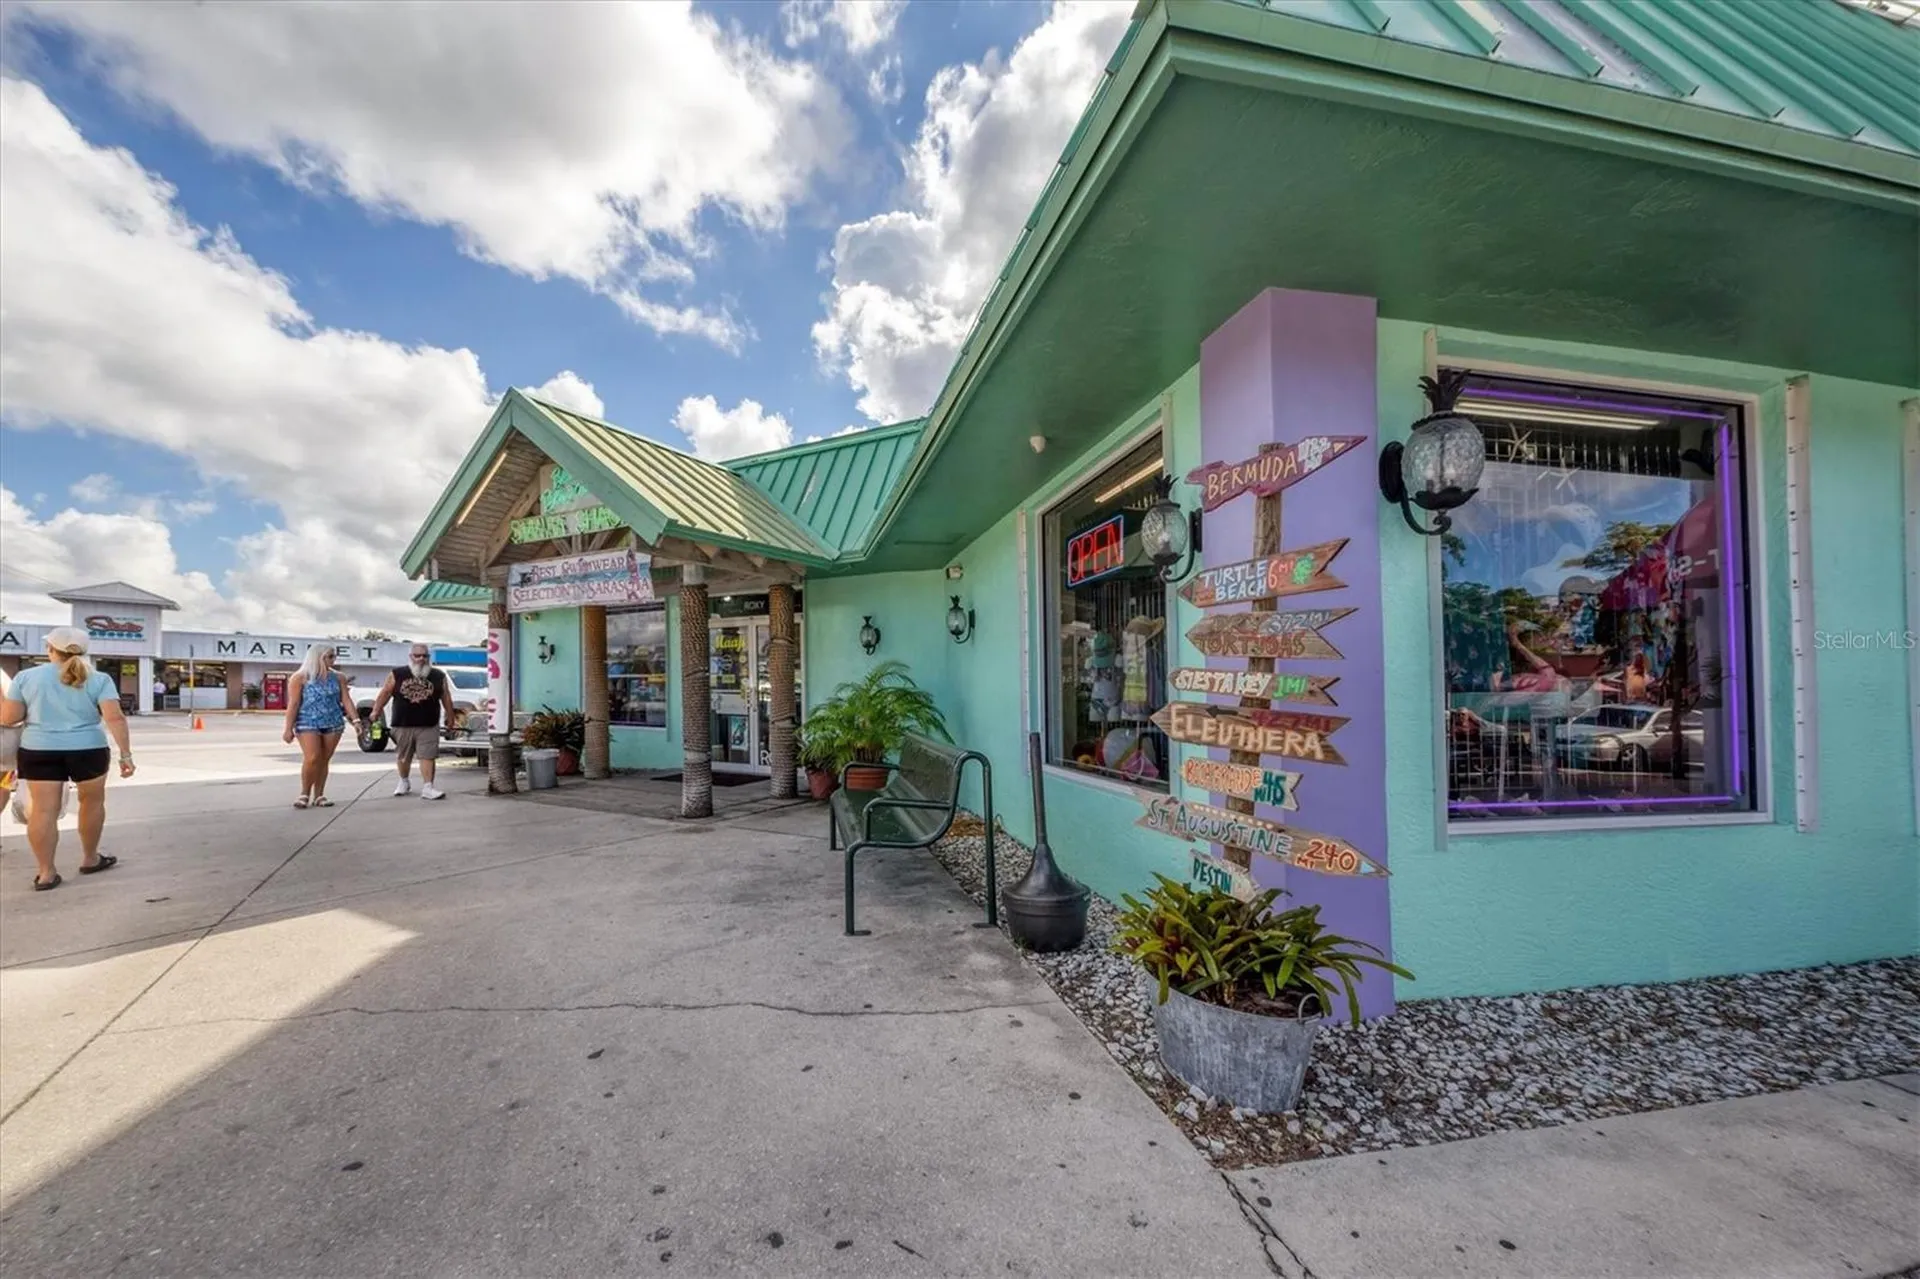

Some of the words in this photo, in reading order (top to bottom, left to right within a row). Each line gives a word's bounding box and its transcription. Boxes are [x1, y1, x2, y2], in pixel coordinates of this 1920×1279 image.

[1207, 451, 1298, 500] BERMUDA
[1070, 523, 1122, 582] OPEN
[531, 565, 557, 582] BEST
[1199, 560, 1268, 588] TURTLE
[1268, 559, 1278, 589] 6
[513, 585, 570, 606] SELECTION
[1215, 578, 1267, 601] BEACH
[217, 640, 377, 659] MARET
[1175, 669, 1234, 693] SIESTA
[1234, 671, 1273, 697] KEY
[1170, 705, 1325, 760] ELEUTHERA
[1174, 804, 1293, 856] AUGUSTINE
[1304, 839, 1357, 872] 240
